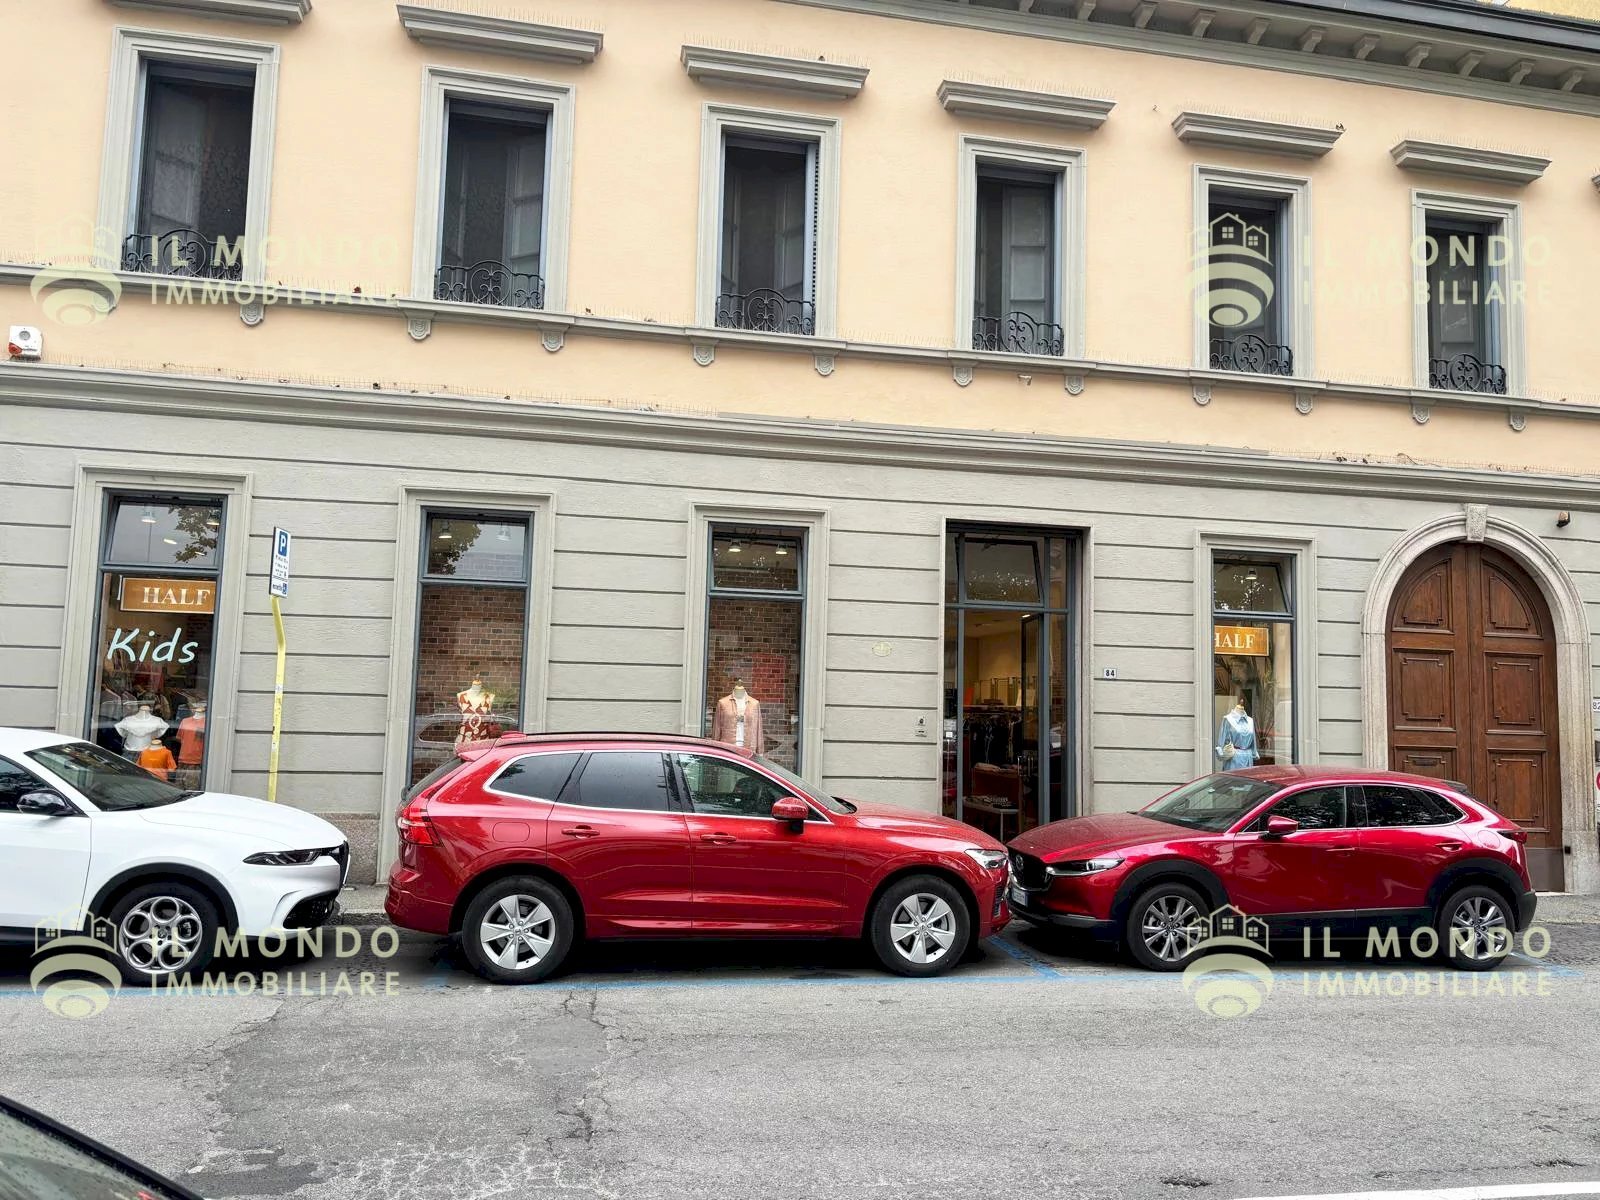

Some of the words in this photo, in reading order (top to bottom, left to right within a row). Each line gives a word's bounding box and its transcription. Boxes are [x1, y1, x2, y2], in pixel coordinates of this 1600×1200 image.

[142, 586, 211, 606] HALF
[107, 627, 199, 664] Kids
[1105, 669, 1115, 677] 84
